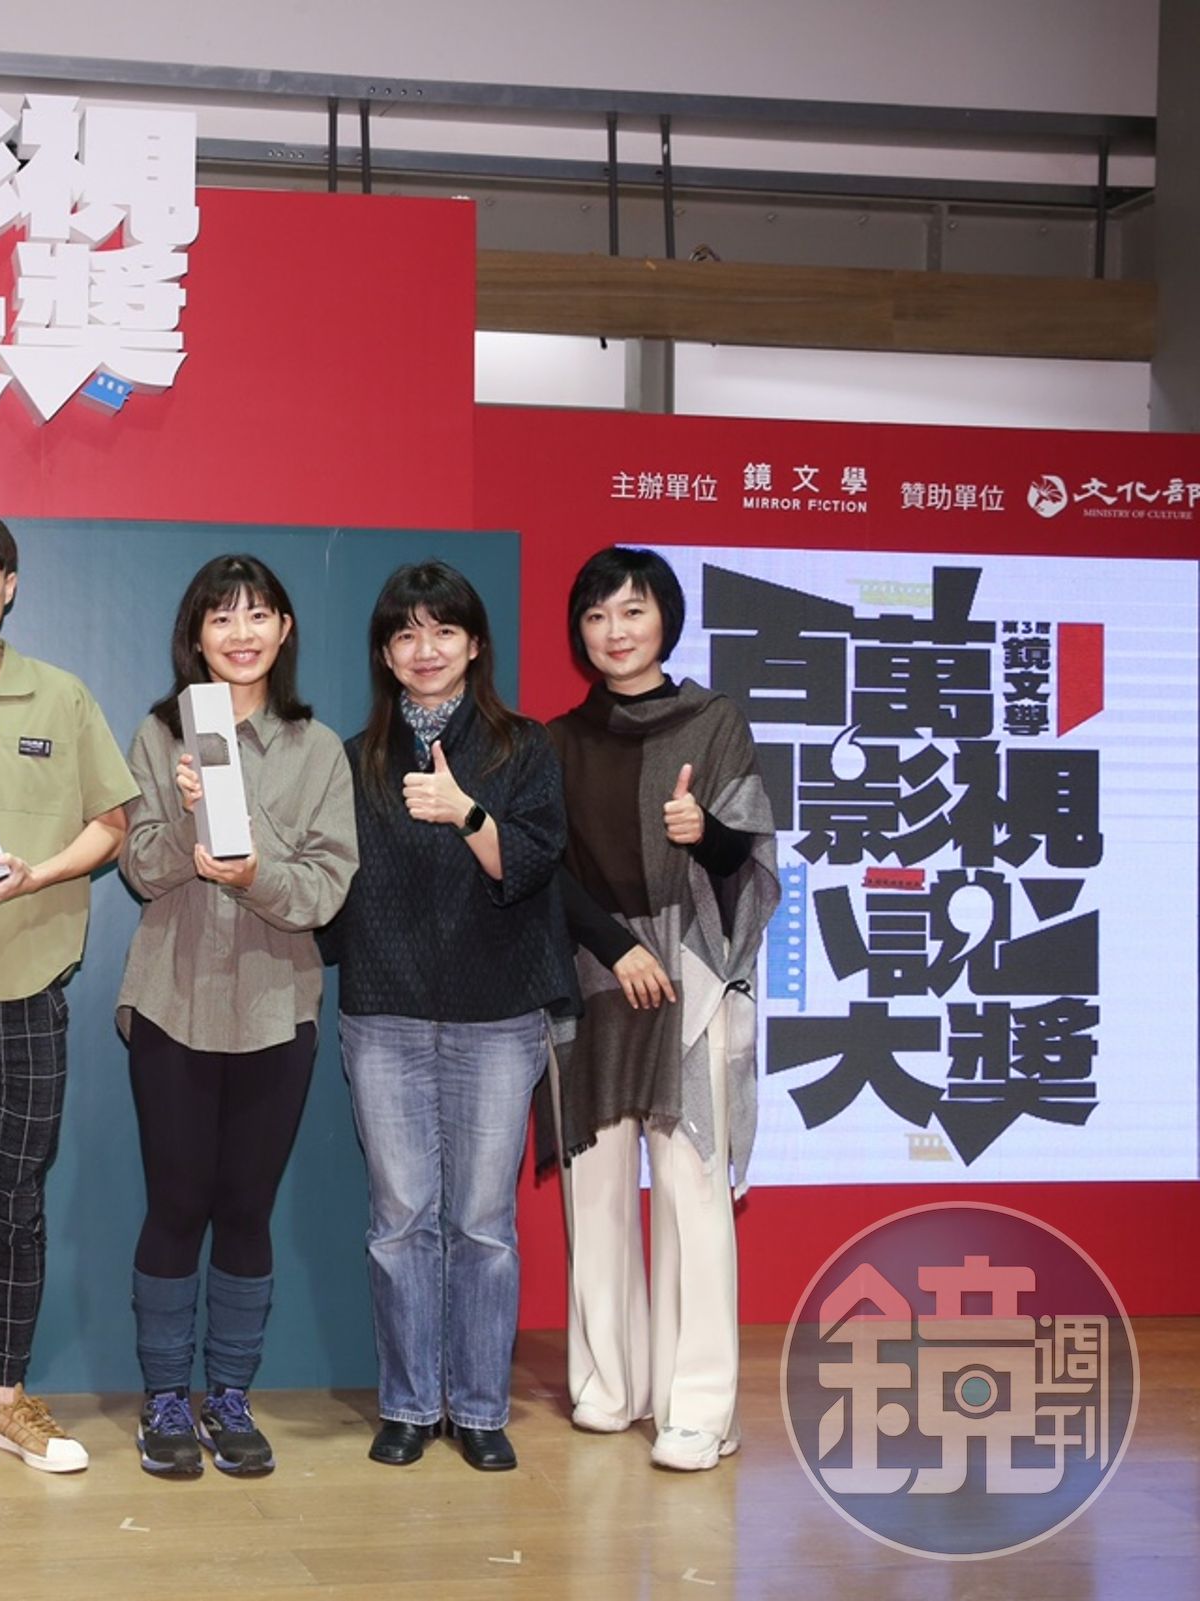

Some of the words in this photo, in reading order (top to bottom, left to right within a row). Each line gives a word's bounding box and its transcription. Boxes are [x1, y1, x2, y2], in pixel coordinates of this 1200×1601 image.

[611, 472, 718, 501] 主辦單位
[901, 482, 1005, 511] 贊助單位
[1073, 478, 1200, 507] 文化部
[743, 497, 800, 510] MIRROR
[1083, 508, 1130, 518] MINISTRY
[1132, 509, 1146, 518] OF
[1148, 510, 1193, 520] CULTURE
[766, 997, 1100, 1167] 大獎
